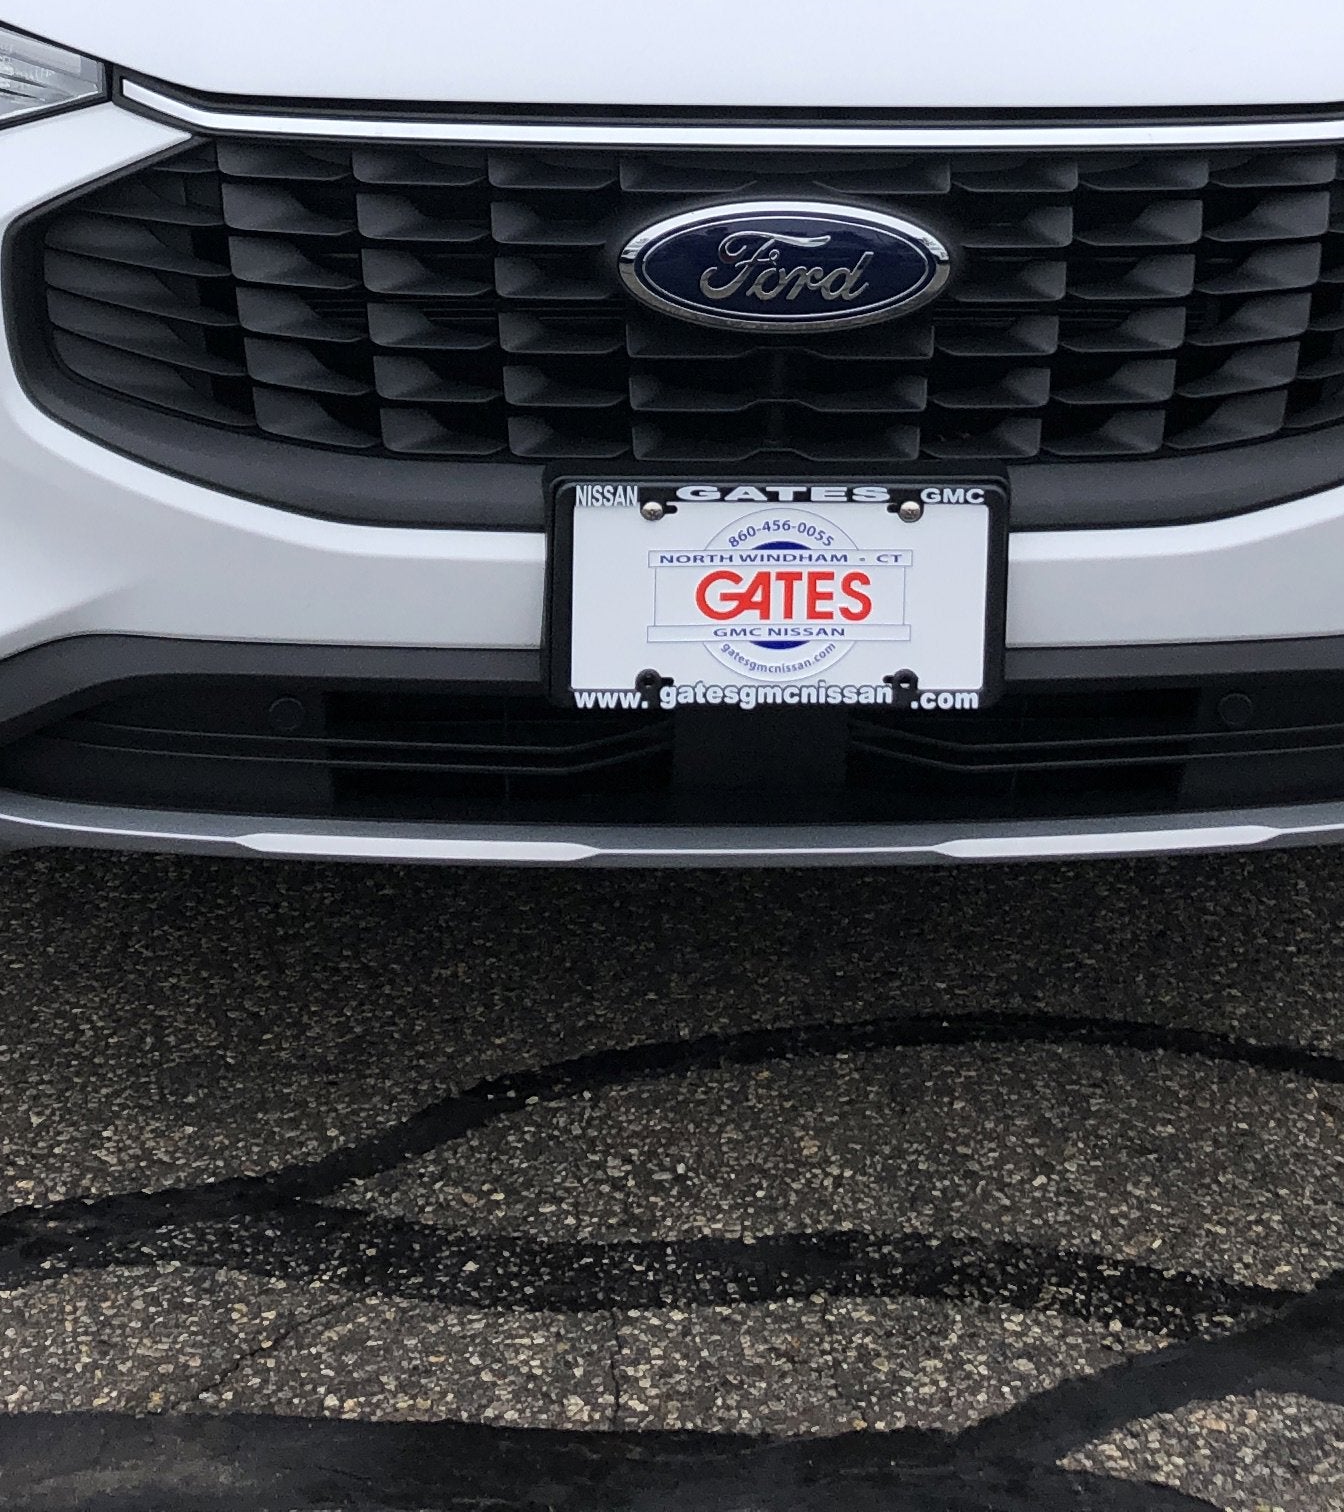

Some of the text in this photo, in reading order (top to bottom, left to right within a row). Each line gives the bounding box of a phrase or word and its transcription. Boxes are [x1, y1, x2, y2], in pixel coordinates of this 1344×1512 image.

[699, 230, 875, 301] Ford
[575, 484, 985, 507] NISSAN GATES GMC
[727, 519, 835, 548] 860-456-0055
[659, 553, 903, 564] NORTH WINDHAM CT
[695, 569, 873, 621] GATES
[712, 627, 846, 637] GMC NISSAN
[720, 642, 836, 674] gatesgmcnissan.com
[574, 681, 979, 710] www. gatesgmcnissan .com
